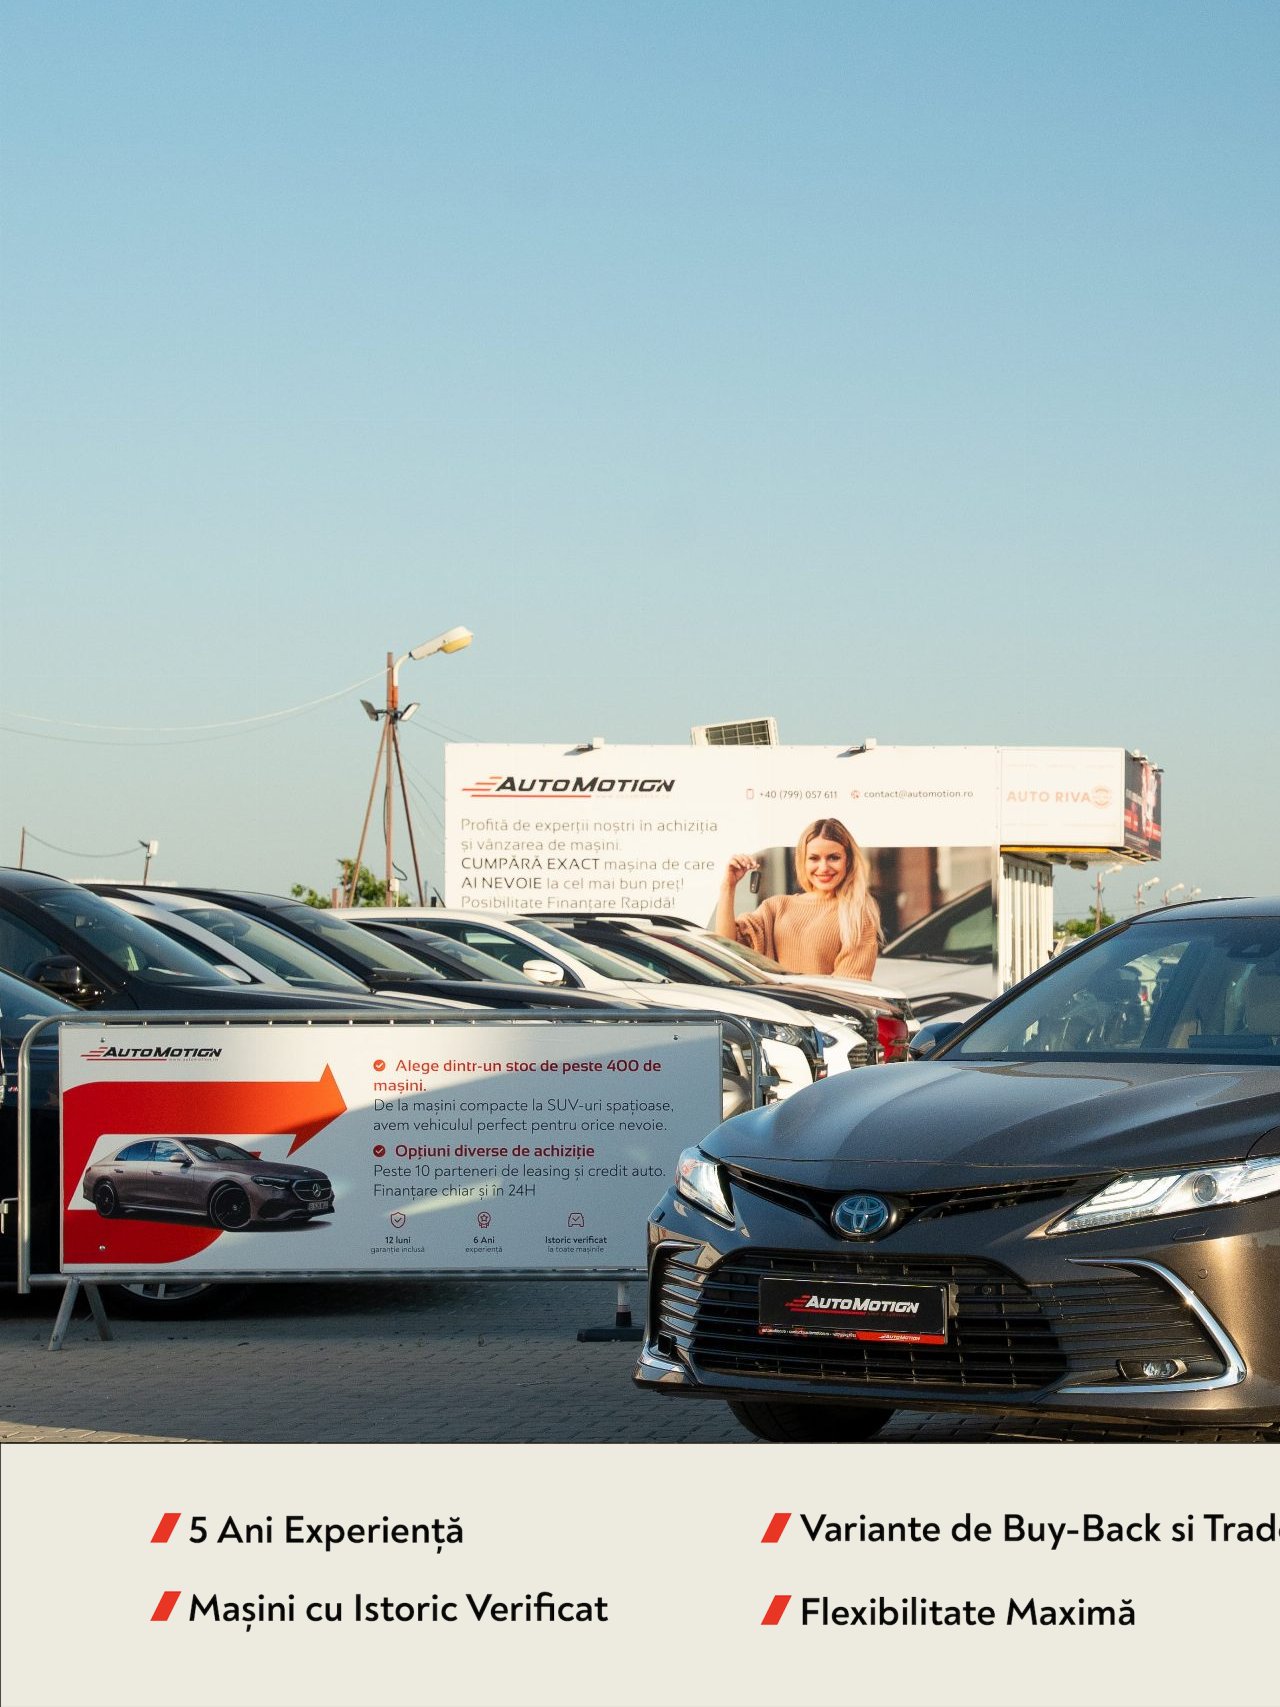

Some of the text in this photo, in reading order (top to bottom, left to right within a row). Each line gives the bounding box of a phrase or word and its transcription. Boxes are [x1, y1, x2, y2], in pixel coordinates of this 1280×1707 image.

[760, 790, 837, 800] +40 (799) 057 611
[863, 790, 974, 799] contact@automotion.ro
[1007, 791, 1092, 802] AUTO RIVA
[461, 818, 718, 834] Profită de experții noștri în achiziția
[461, 841, 472, 852] și
[477, 838, 544, 850] vânzarea
[548, 839, 566, 851] de
[462, 856, 714, 872] CUMPĂRĂ EXACT mașina de care
[462, 877, 683, 892] AI NEVOIE la cel mai bun preț!
[461, 896, 675, 911] Posibilitate Finanțare Rapidă!
[396, 1059, 662, 1075] Alege dintr-un stoc de peste 400 de
[374, 1079, 427, 1094] mașini.
[374, 1099, 674, 1115] De la mașini compacte la SUV-uri spațioase,
[373, 1118, 668, 1134] avem vehiculul perfect pentru orice nevoie.
[396, 1144, 595, 1159] Opțiuni diverse de achiziție
[374, 1164, 667, 1181] Peste 10 parteneri de leasing și credit auto.
[374, 1184, 536, 1200] Finanțare chiar și în 24H
[385, 1236, 410, 1244] 12 luni
[473, 1235, 494, 1244] 6 Ani
[545, 1235, 608, 1244] Istoric verificat
